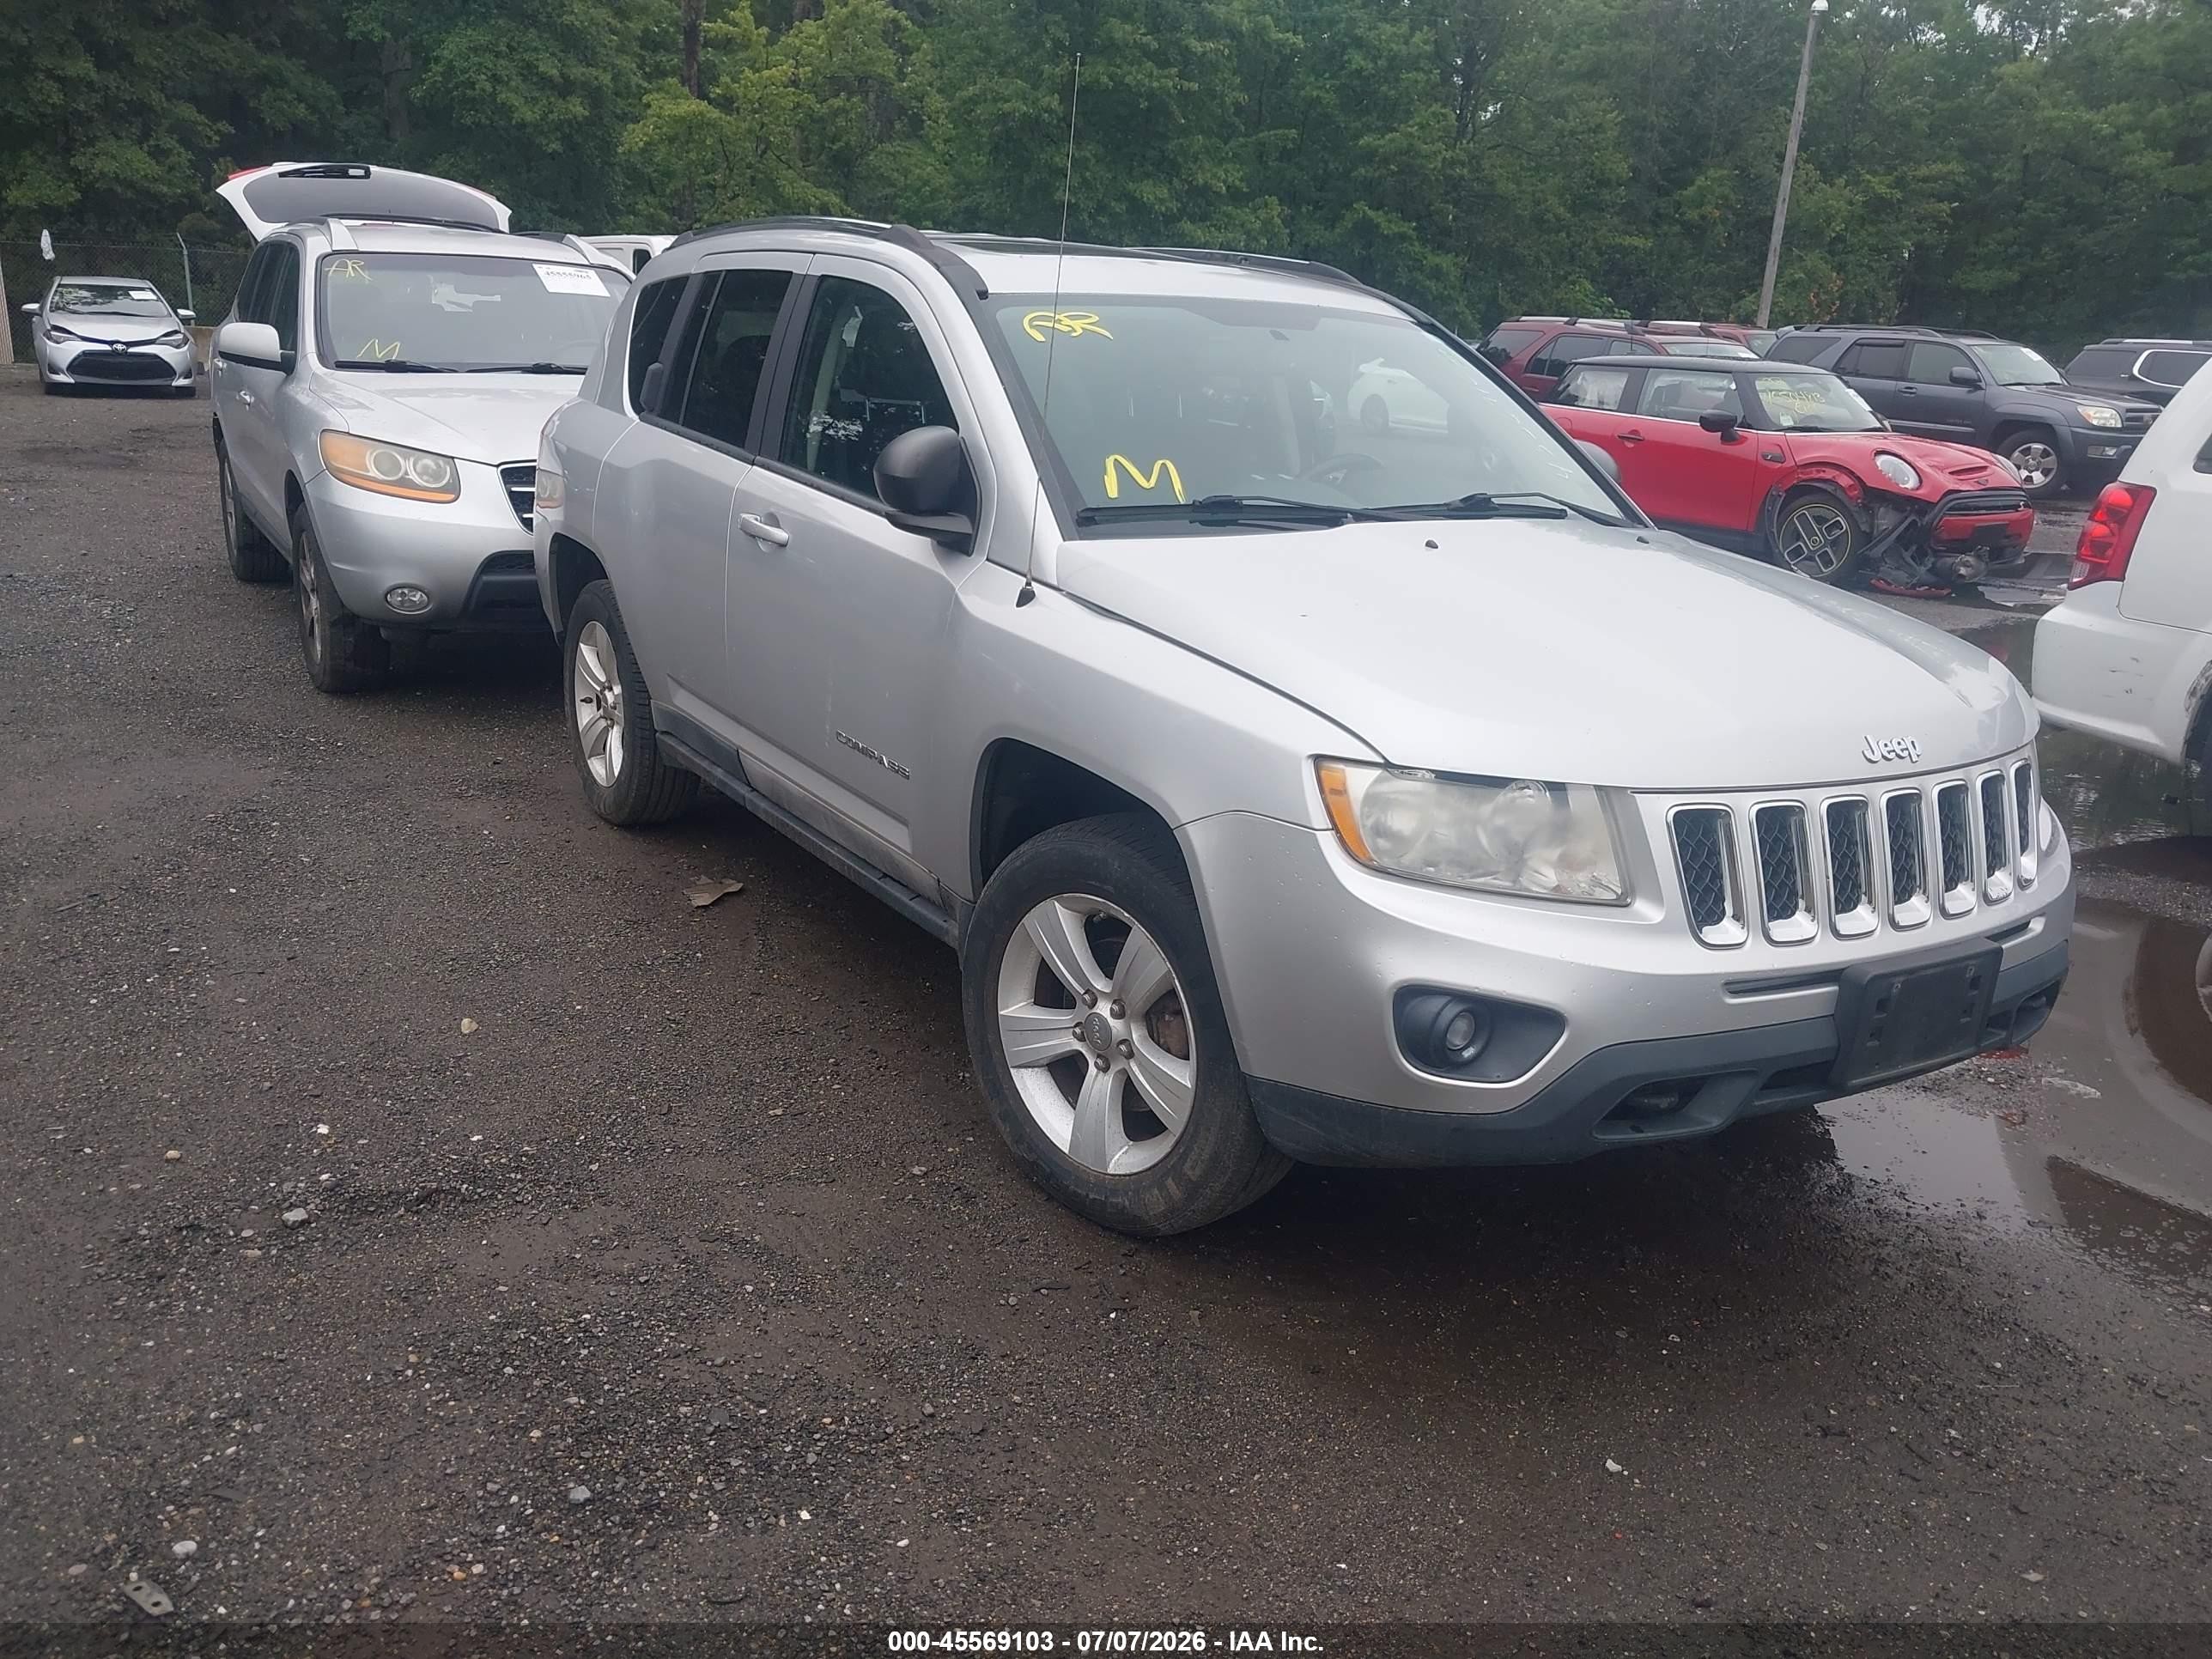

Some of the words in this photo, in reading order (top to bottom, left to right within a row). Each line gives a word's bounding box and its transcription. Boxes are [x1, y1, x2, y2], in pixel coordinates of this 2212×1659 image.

[356, 337, 401, 360] M
[1104, 454, 1188, 504] M
[1862, 735, 1922, 764] Jeep
